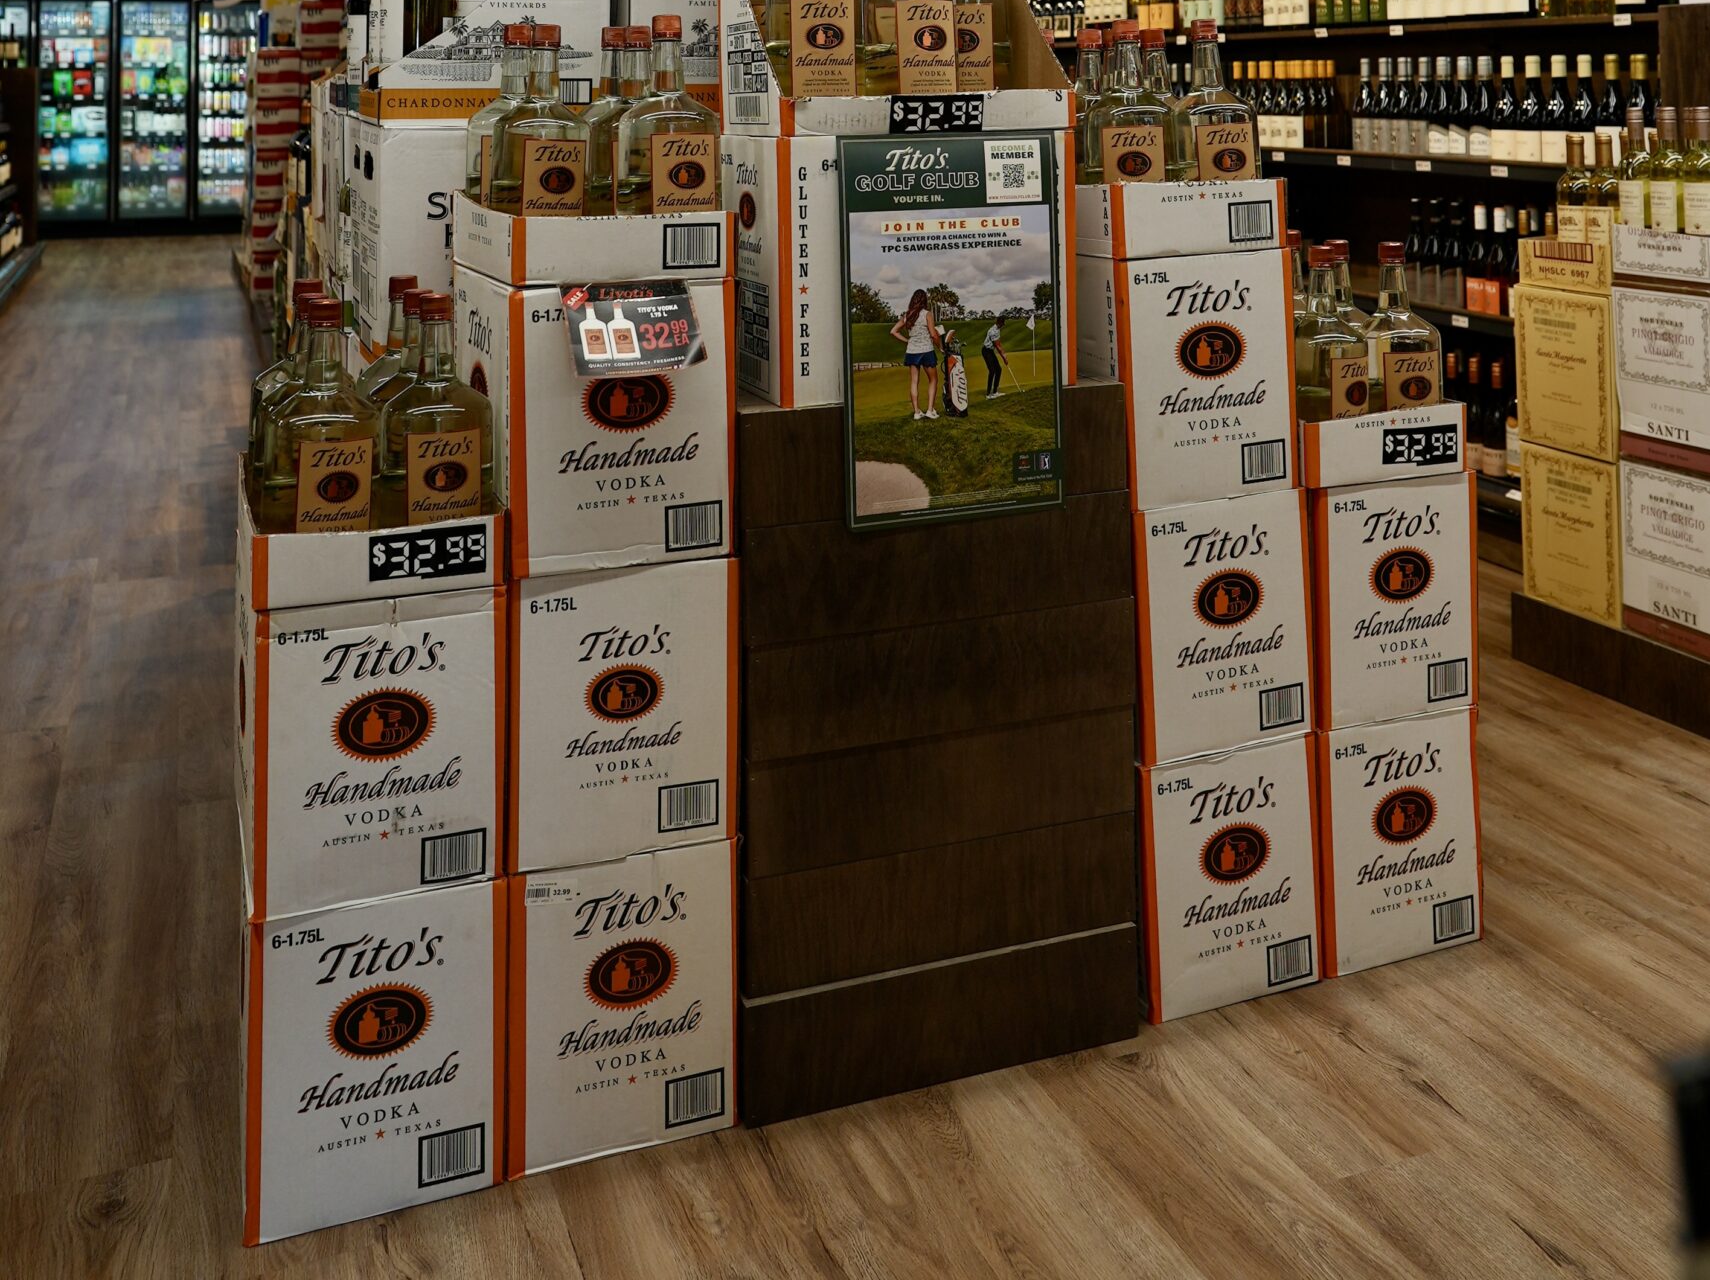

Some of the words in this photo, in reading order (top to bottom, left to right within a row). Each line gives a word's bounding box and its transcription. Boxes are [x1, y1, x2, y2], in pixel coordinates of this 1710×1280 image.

[800, 1, 848, 19] Tito's
[907, 3, 949, 21] Tito's
[795, 53, 854, 68] Handmade
[903, 54, 956, 68] Handmade
[387, 98, 498, 108] CHARDONNAY
[893, 100, 983, 132] $32.99
[662, 137, 709, 157] Tito's
[1111, 130, 1156, 148] Tito's
[1206, 127, 1248, 146] Tito's
[534, 143, 580, 163] Tito's
[885, 146, 949, 171] Tito's
[736, 161, 758, 186] Tito's
[855, 172, 916, 192] GOLF
[920, 171, 979, 188] CLUB
[525, 197, 582, 210] Handmade
[656, 192, 715, 207] Handmade
[893, 195, 928, 203] YOU'RE
[931, 194, 944, 202] IN.
[1161, 194, 1194, 203] AUSTIN
[1212, 191, 1243, 200] TEXAS
[798, 166, 809, 278] GLUTEN
[884, 222, 925, 232] JOIN
[939, 221, 967, 230] THE
[980, 218, 1020, 228] CLUB
[881, 245, 901, 253] TPC
[903, 242, 960, 252] SAWGRASS
[961, 239, 1022, 249] EXPERIENCE
[1134, 272, 1170, 285] 6-1.75L
[1539, 265, 1566, 276] NHSLC
[1571, 269, 1590, 279] 6967
[567, 291, 584, 306] SALE
[657, 304, 678, 312] VODKA
[1166, 280, 1250, 317] Tito's
[468, 307, 491, 354] Tito's
[639, 322, 672, 351] 32
[670, 320, 689, 333] 99
[674, 334, 690, 346] EA
[799, 303, 811, 377] FREE
[1394, 357, 1435, 374] Tito's
[956, 366, 968, 407] Tito's
[1158, 380, 1267, 416] Handmade
[1187, 416, 1243, 432] VODKA
[1355, 420, 1386, 429] AUSTIN
[1402, 416, 1432, 425] TEXAS
[1647, 422, 1690, 442] SANTI
[417, 436, 472, 460] Tito's
[1174, 437, 1207, 448] AUSTIN
[1225, 431, 1257, 442] TEXAS
[1384, 432, 1457, 462] $32.99
[310, 445, 365, 469] Tito's
[558, 431, 700, 474] Handmade
[596, 474, 666, 493] VODKA
[411, 491, 479, 513] Handmade
[576, 499, 620, 511] AUSTIN
[644, 492, 685, 504] TEXAS
[1334, 499, 1367, 514] 6-1.75L
[301, 502, 369, 523] Handmade
[1152, 521, 1187, 537] 6-1.75L
[1362, 505, 1440, 544] Tito's
[372, 532, 485, 578] $32.99
[1183, 524, 1268, 567] Tito's
[530, 597, 577, 614] 6-1.75L
[1653, 599, 1697, 625] SANTI
[1353, 601, 1452, 640] Handmade
[277, 628, 329, 645] 6-1.75L
[578, 624, 671, 662] Tito's
[1176, 624, 1284, 668] Handmade
[1380, 637, 1429, 654] VODKA
[321, 632, 446, 685] Tito's
[1206, 663, 1260, 682] VODKA
[564, 721, 682, 759] Handmade
[1335, 743, 1367, 760] 6-1.75L
[595, 758, 654, 774] VODKA
[1363, 742, 1440, 788] Tito's
[303, 756, 463, 810] Handmade
[579, 778, 615, 790] AUSTIN
[635, 771, 670, 782] TEXAS
[1157, 777, 1194, 796] 6-1.75L
[1189, 776, 1275, 824] Tito's
[344, 804, 424, 827] VODKA
[322, 832, 371, 848] AUSTIN
[398, 821, 446, 837] TEXAS
[1357, 838, 1456, 886] Handmade
[1383, 877, 1433, 898] VODKA
[573, 883, 686, 940] Tito's
[1183, 876, 1292, 928] Handmade
[272, 928, 325, 949] 6-1.75L
[1212, 918, 1268, 940] VODKA
[316, 927, 444, 985] Tito's
[556, 1000, 702, 1058] Handmade
[595, 1048, 667, 1072] VODKA
[297, 1050, 460, 1114] Handmade
[575, 1077, 619, 1094] AUSTIN
[643, 1063, 687, 1079] TEXAS
[340, 1102, 421, 1129] VODKA
[317, 1135, 367, 1153] AUSTIN
[394, 1119, 442, 1136] TEXAS
